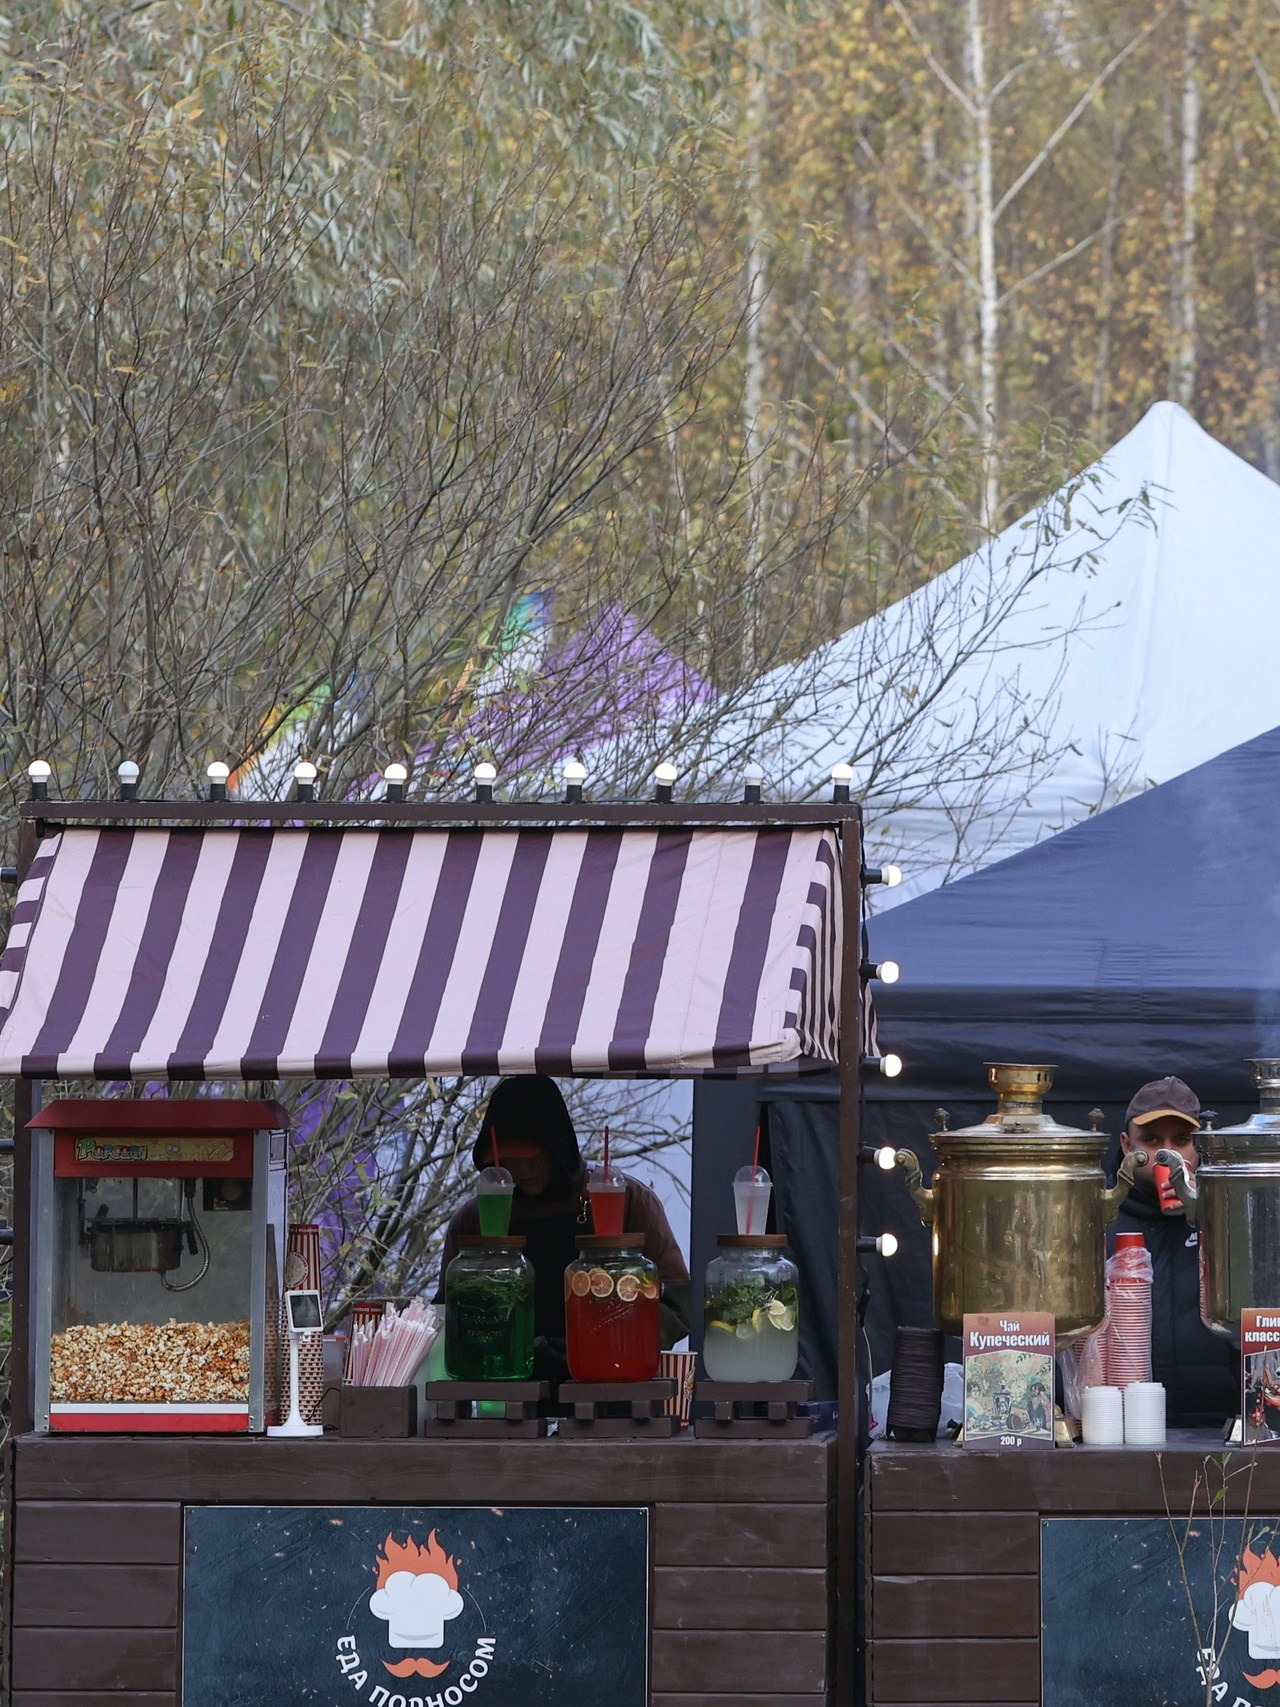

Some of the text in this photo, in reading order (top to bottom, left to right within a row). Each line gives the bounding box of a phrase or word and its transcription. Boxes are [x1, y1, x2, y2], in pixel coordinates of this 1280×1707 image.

[999, 1320, 1020, 1332] Чай
[969, 1331, 1050, 1350] Купеческий
[1000, 1436, 1015, 1446] 200
[335, 1634, 368, 1691] ЕДА
